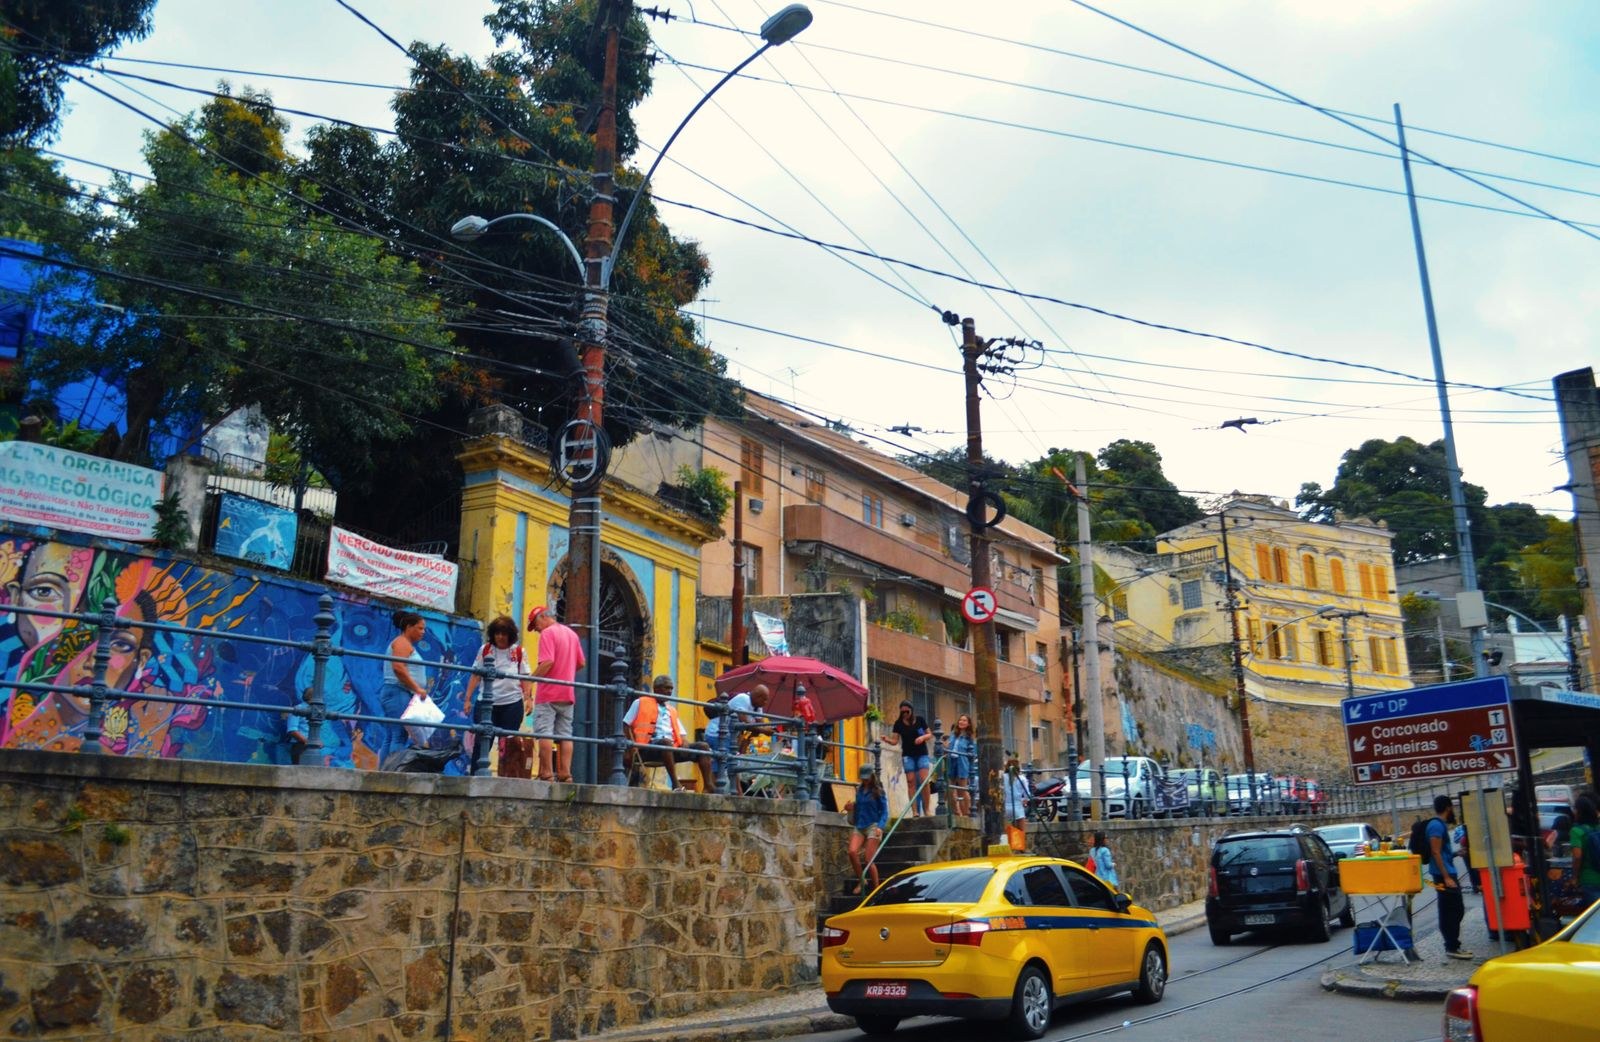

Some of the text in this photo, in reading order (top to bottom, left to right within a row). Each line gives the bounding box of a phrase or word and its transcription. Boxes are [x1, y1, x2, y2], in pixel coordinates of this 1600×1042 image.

[62, 455, 155, 488] ORGÂNICA
[416, 557, 453, 576] PULGAS
[1388, 698, 1408, 713] DP
[1371, 718, 1448, 740] Corcovado
[1373, 738, 1438, 757] Paineiras
[1381, 755, 1486, 778] Lgo. das Neves
[867, 985, 906, 996] KRB-9326
